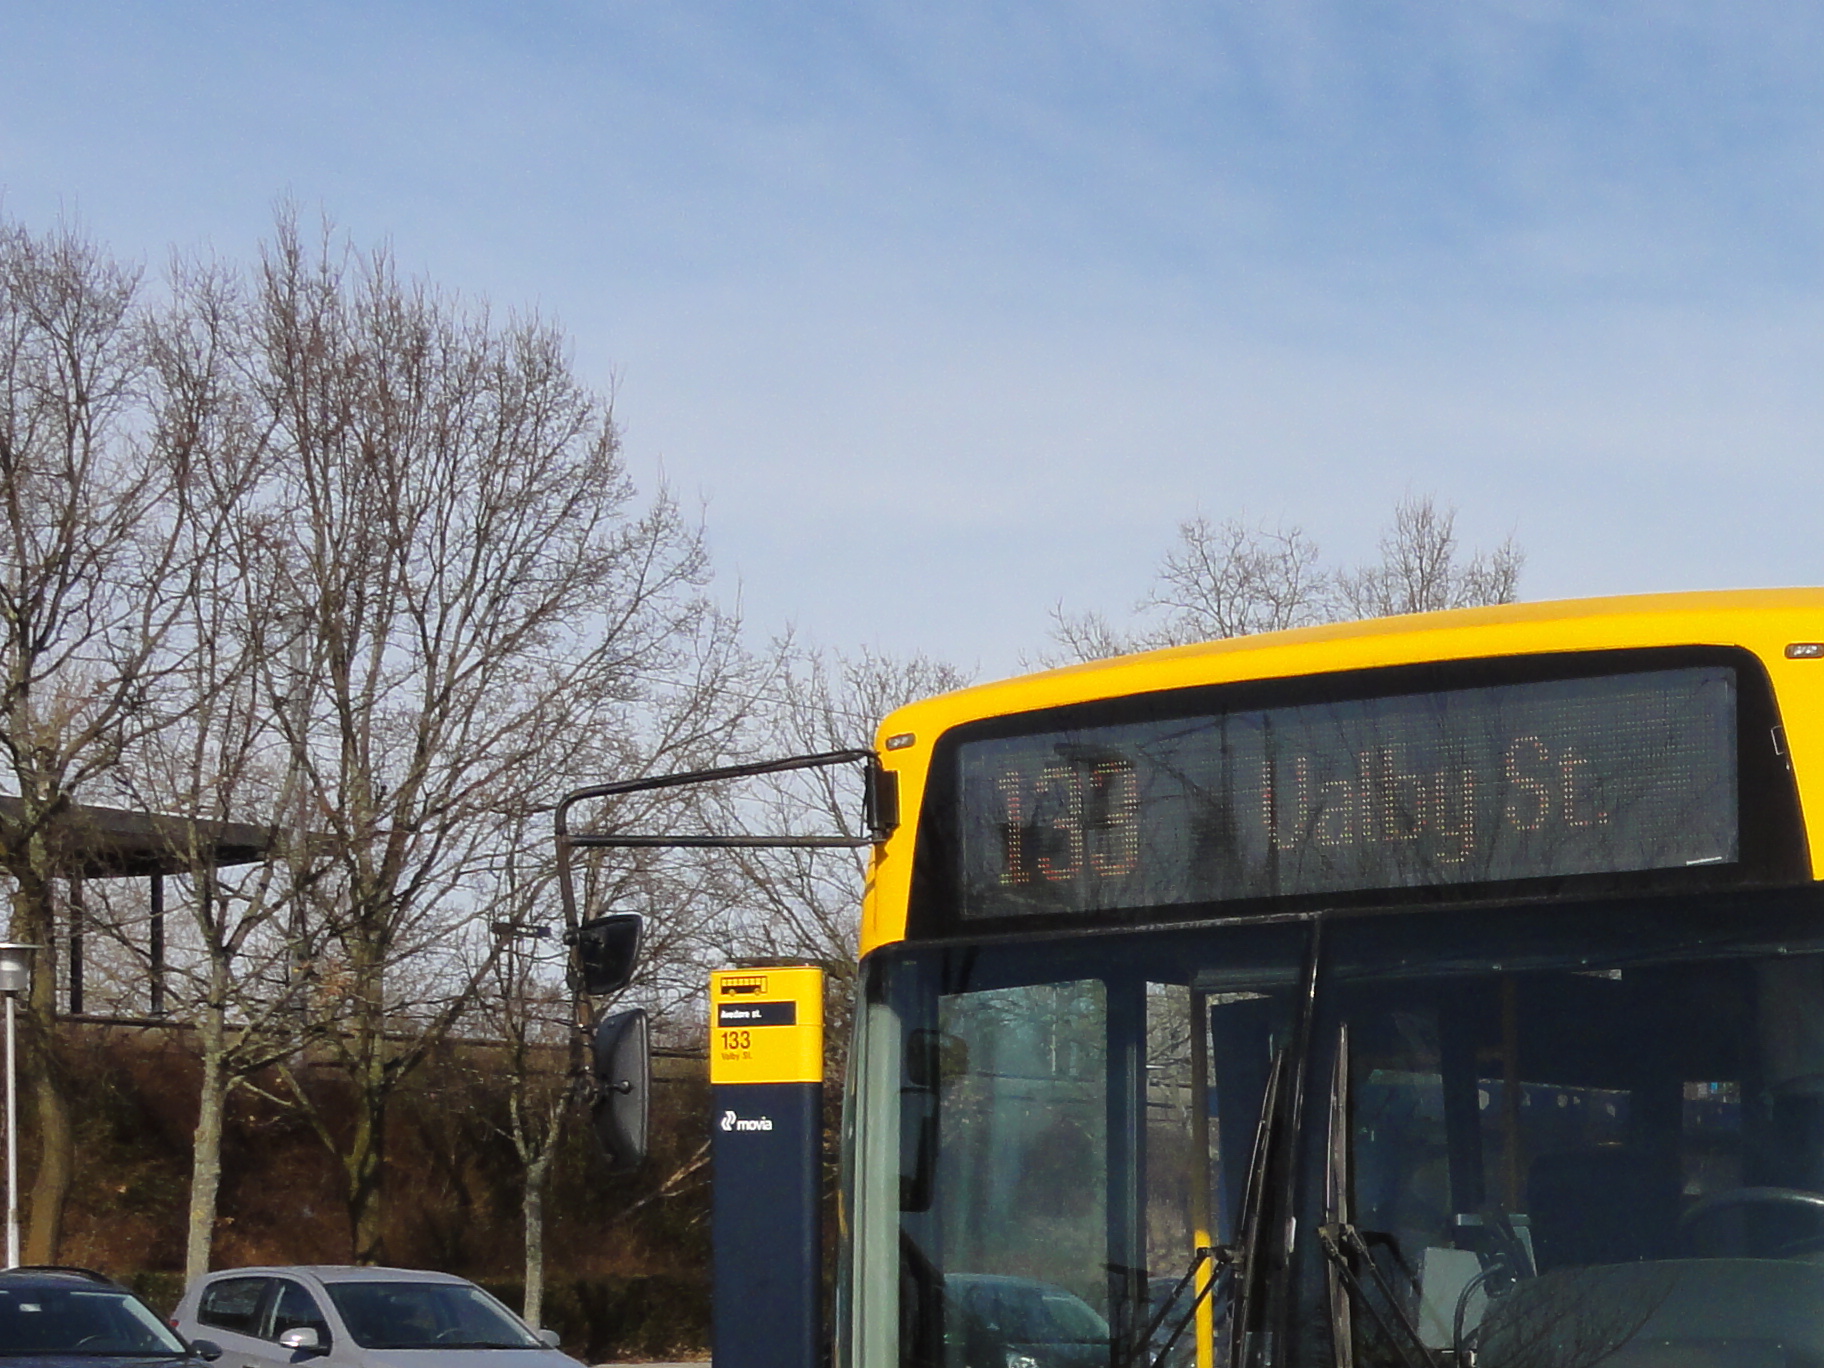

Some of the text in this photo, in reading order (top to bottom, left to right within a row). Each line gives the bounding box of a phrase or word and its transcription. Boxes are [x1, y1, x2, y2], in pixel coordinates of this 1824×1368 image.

[999, 735, 1609, 886] 133 Valby St.
[721, 1030, 751, 1050] 133
[736, 1116, 773, 1132] movia
